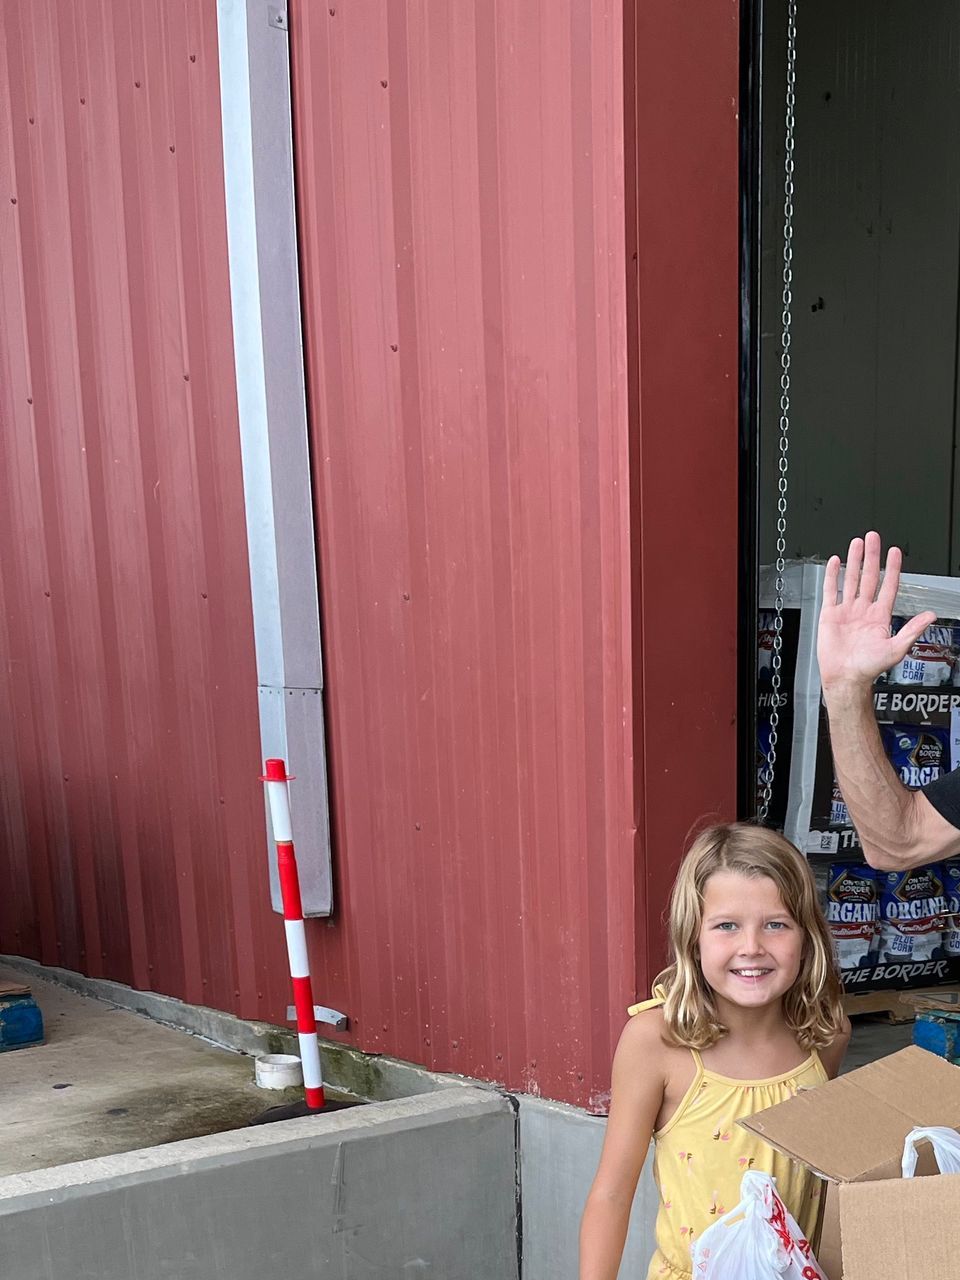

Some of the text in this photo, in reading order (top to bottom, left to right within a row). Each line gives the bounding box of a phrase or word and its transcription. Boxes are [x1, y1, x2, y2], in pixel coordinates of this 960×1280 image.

[903, 660, 925, 672] BLUE
[902, 670, 925, 682] CORN
[891, 694, 960, 719] BORDER
[840, 885, 871, 895] BORDER
[892, 941, 914, 953] CORN
[840, 968, 870, 985] THE
